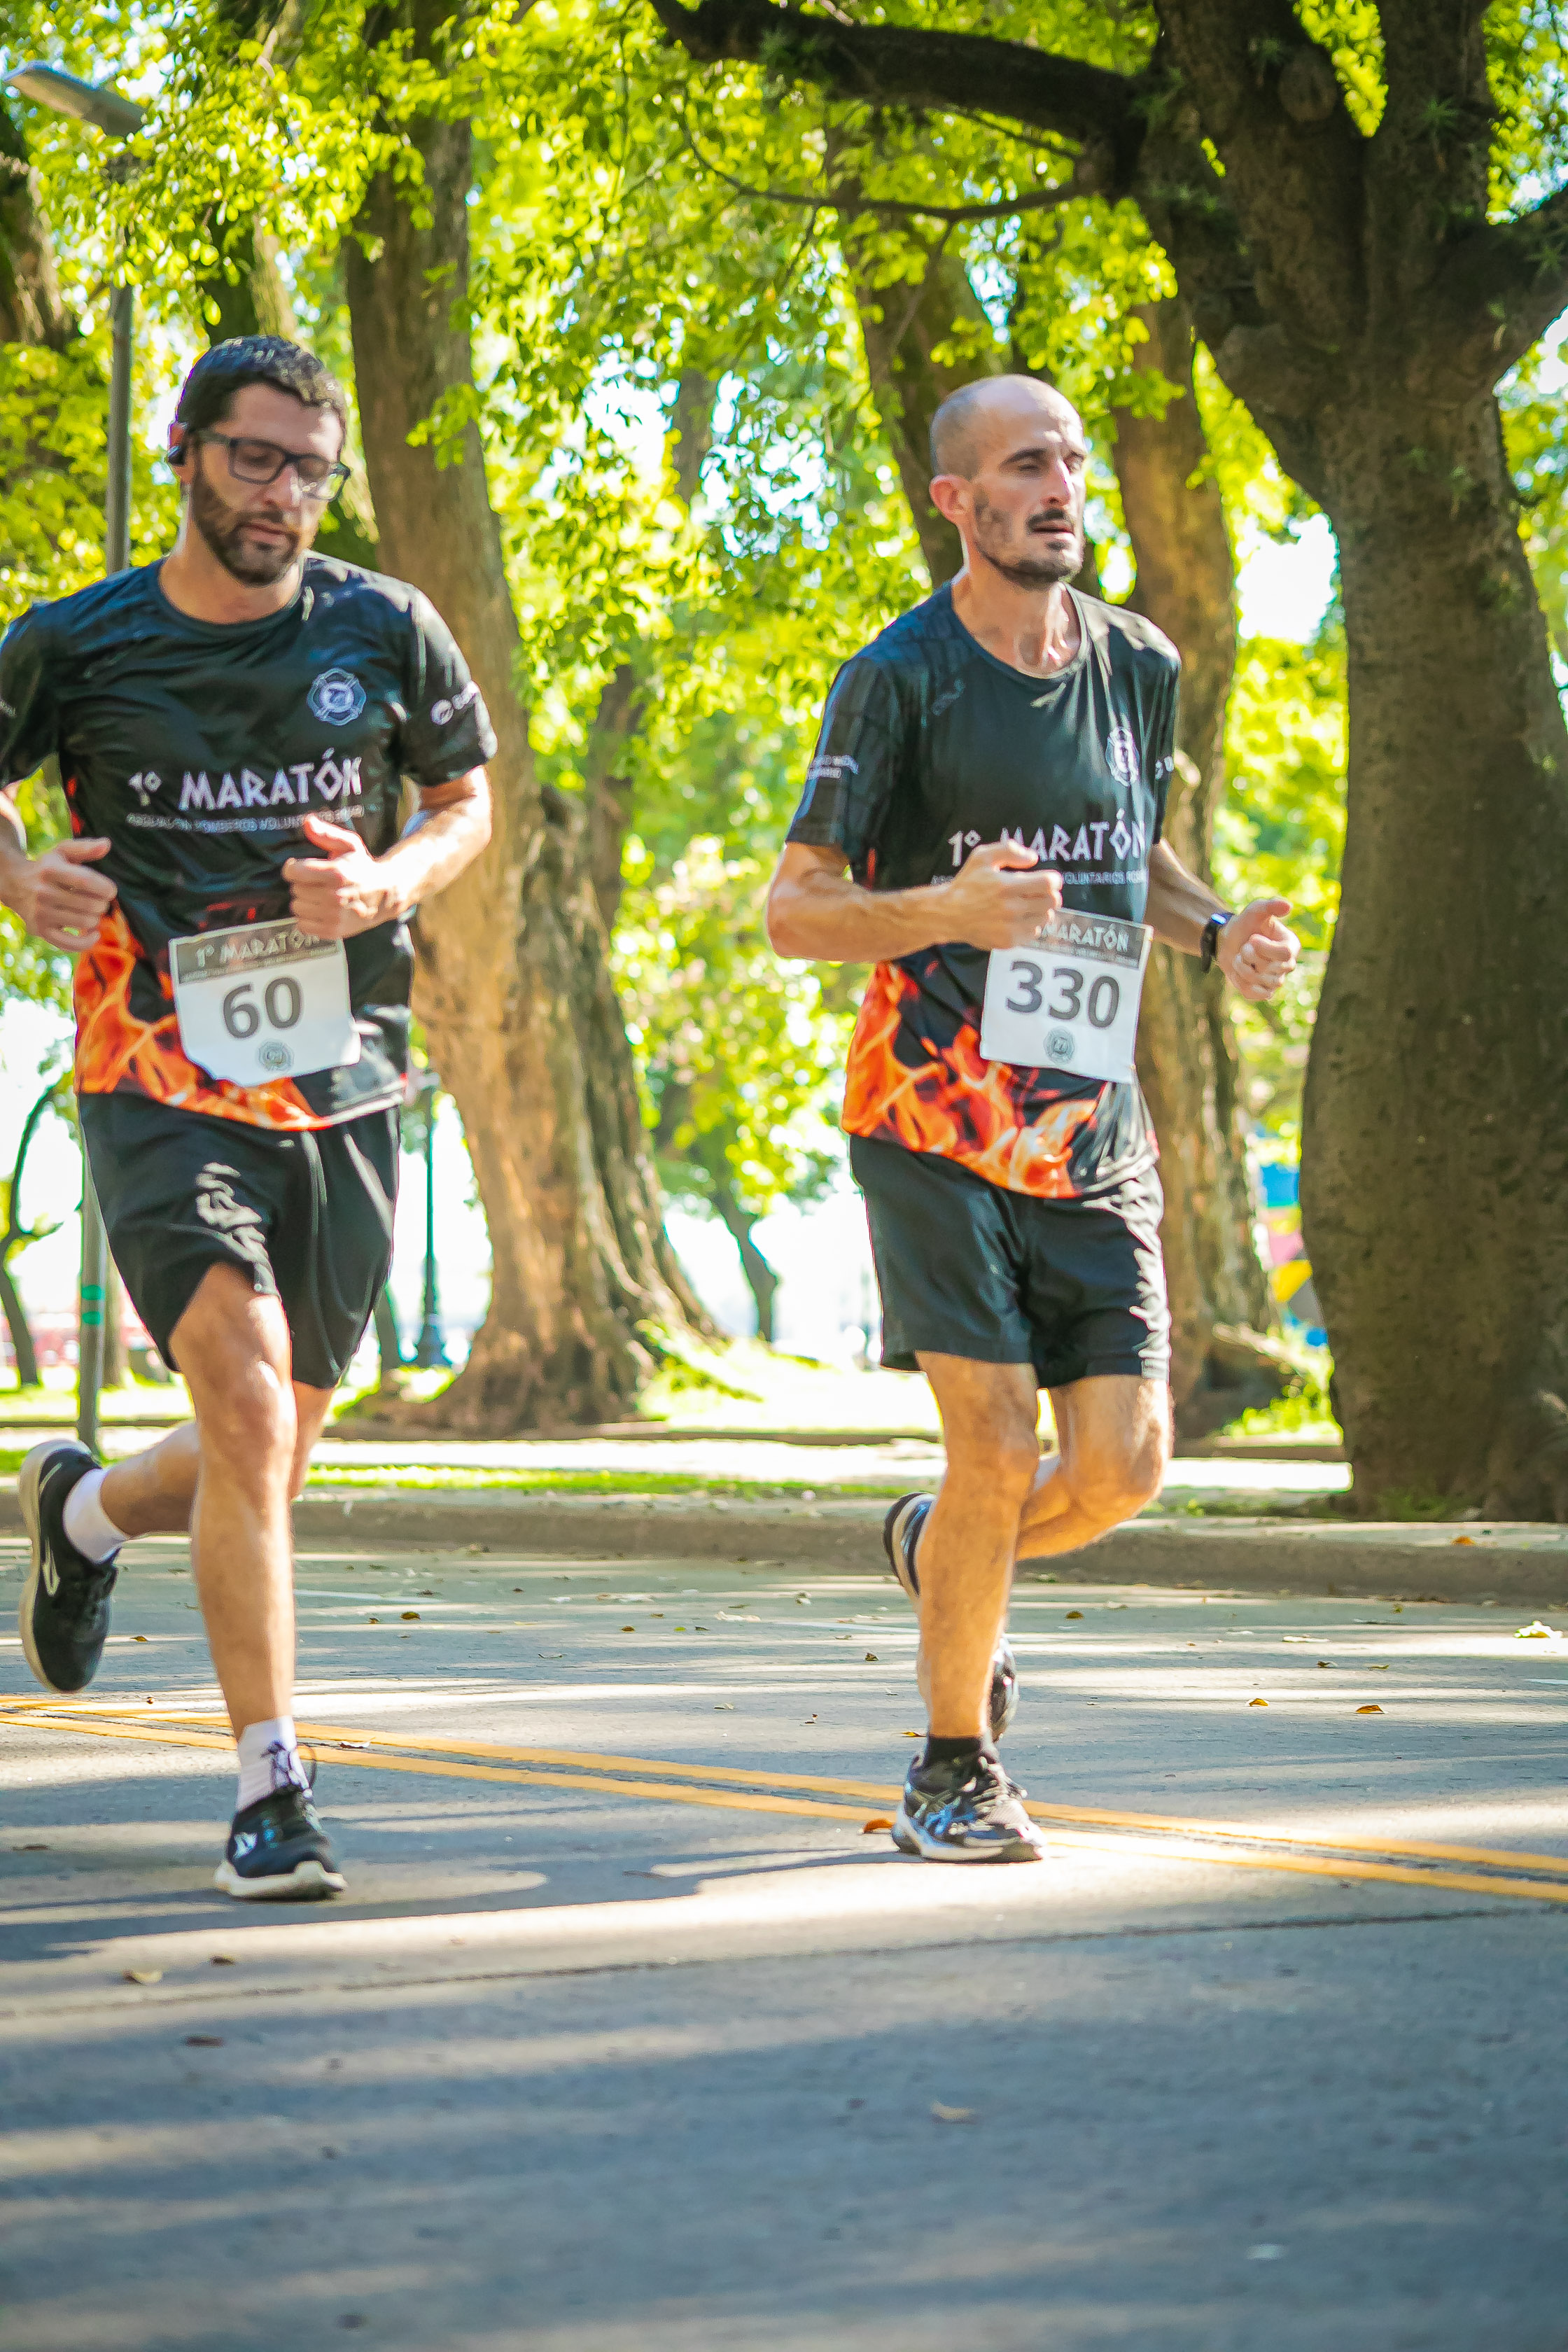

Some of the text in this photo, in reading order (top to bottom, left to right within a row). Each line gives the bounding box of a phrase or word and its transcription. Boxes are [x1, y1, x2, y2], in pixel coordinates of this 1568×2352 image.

[178, 747, 362, 811] MARATÓN
[1063, 871, 1126, 886] OLUNTARIOS
[223, 977, 301, 1039] 60
[1005, 960, 1120, 1028] 330
